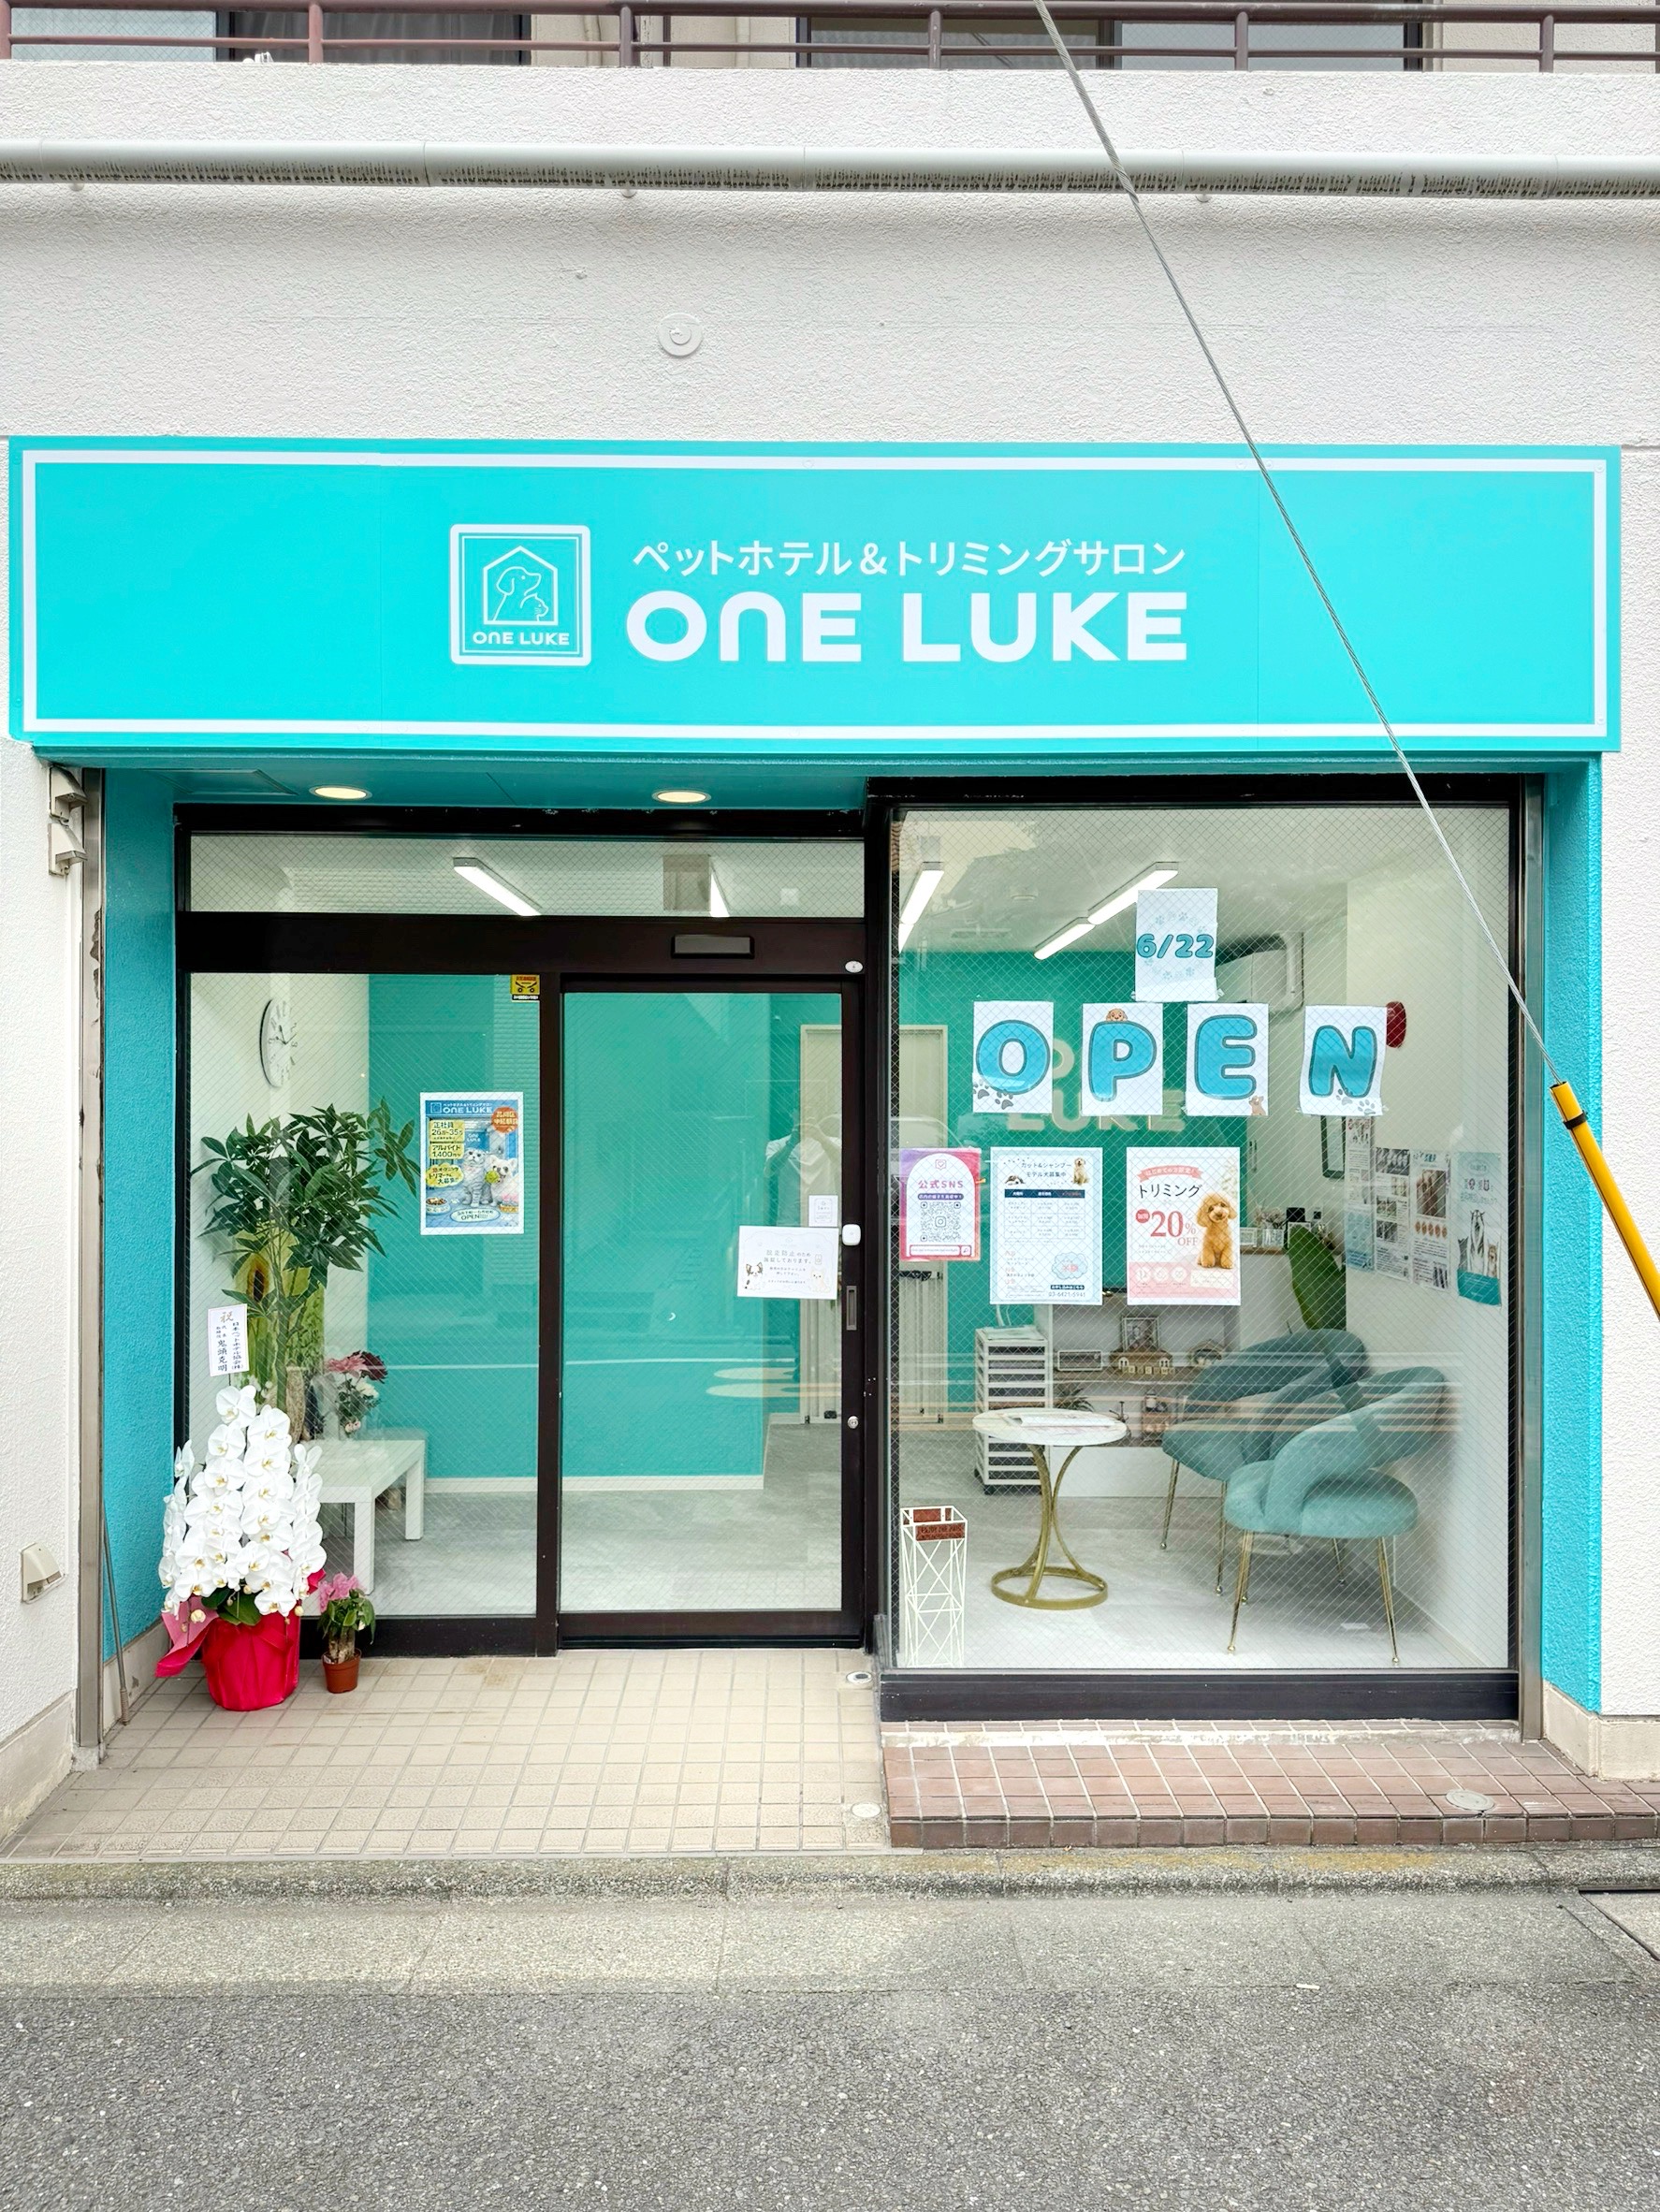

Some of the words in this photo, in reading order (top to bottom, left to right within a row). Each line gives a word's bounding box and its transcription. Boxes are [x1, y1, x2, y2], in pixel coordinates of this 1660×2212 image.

[633, 539, 1186, 576] ペットホテル&トリミングサロン
[903, 591, 1187, 662] LUKE
[519, 632, 570, 646] LUKE
[1136, 933, 1214, 959] 6/22
[918, 1179, 964, 1189] 公式SNS
[1139, 1184, 1202, 1199] トリミング
[1177, 1237, 1199, 1246] OFF
[220, 1311, 234, 1323] 祝
